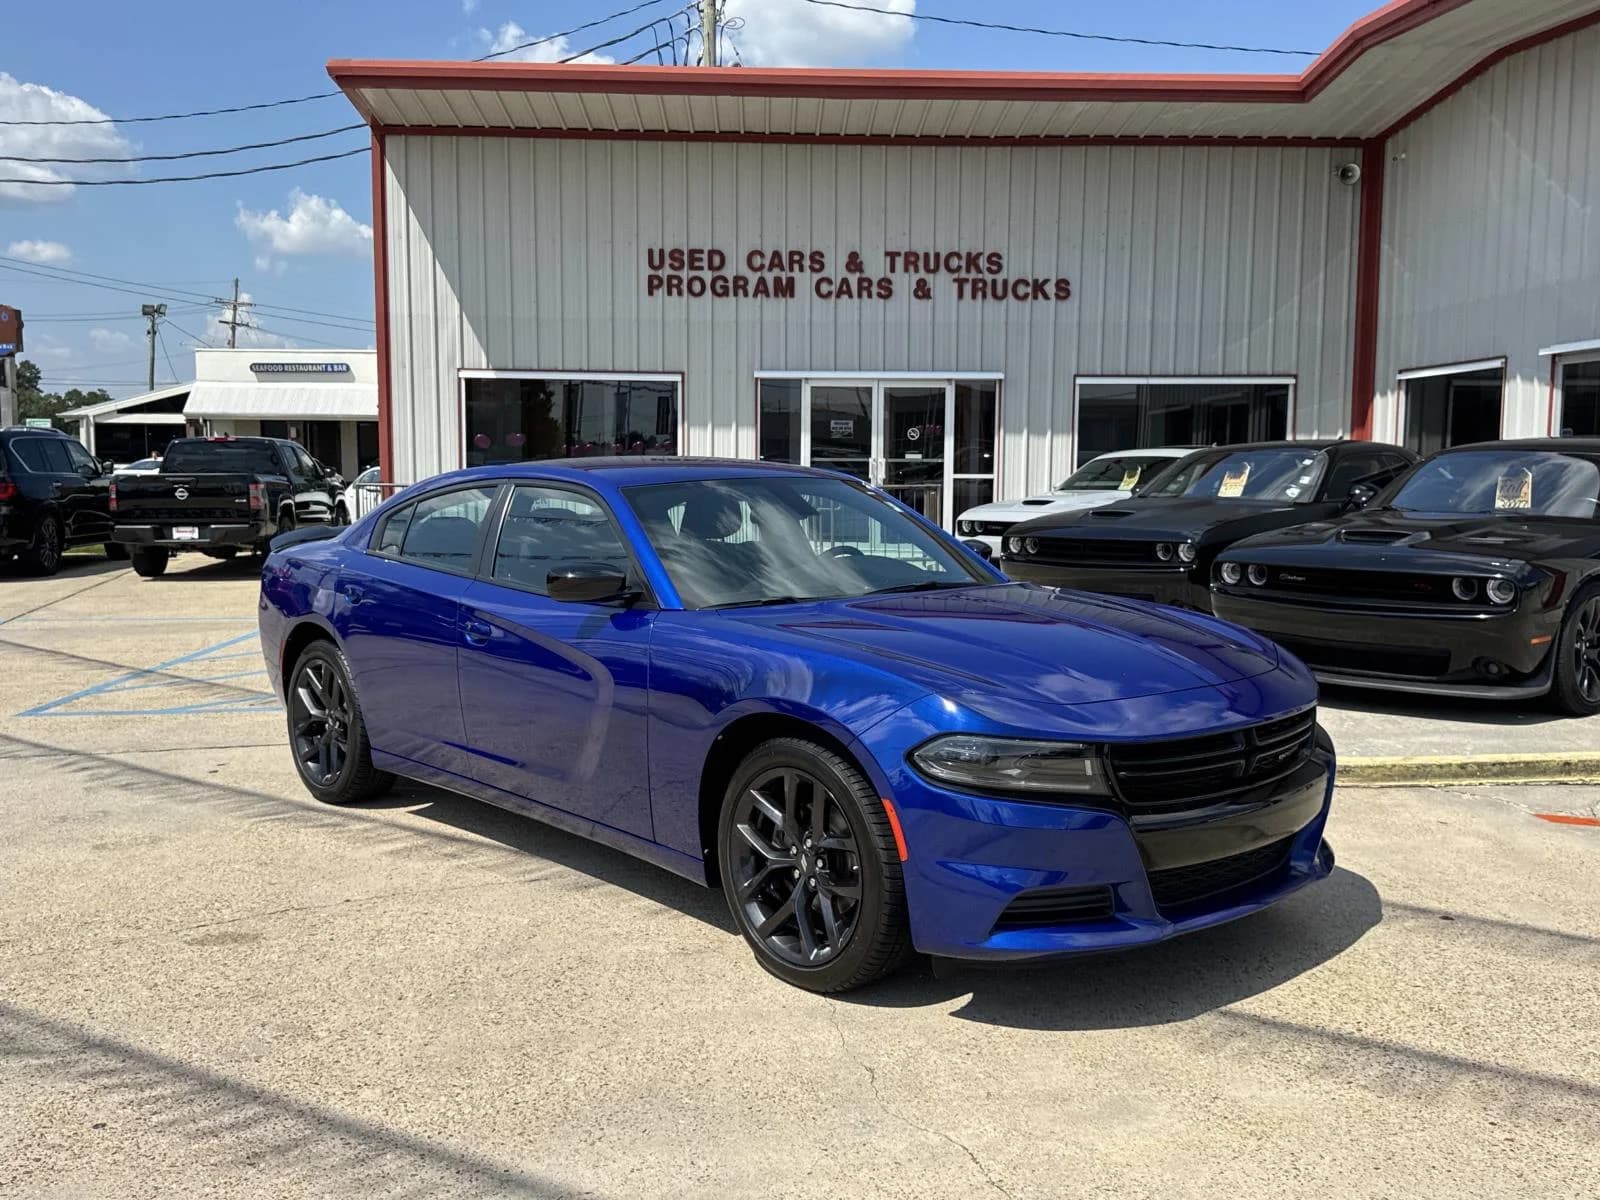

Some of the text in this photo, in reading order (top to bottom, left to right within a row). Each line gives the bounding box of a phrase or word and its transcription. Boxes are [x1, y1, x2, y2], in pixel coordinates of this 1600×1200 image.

[647, 248, 1003, 275] USED CARS & TRUCKS
[647, 274, 1071, 301] PROGRAM CARS & TRUCKS
[251, 364, 347, 372] SEAFOOD RESTAURANT & BAR
